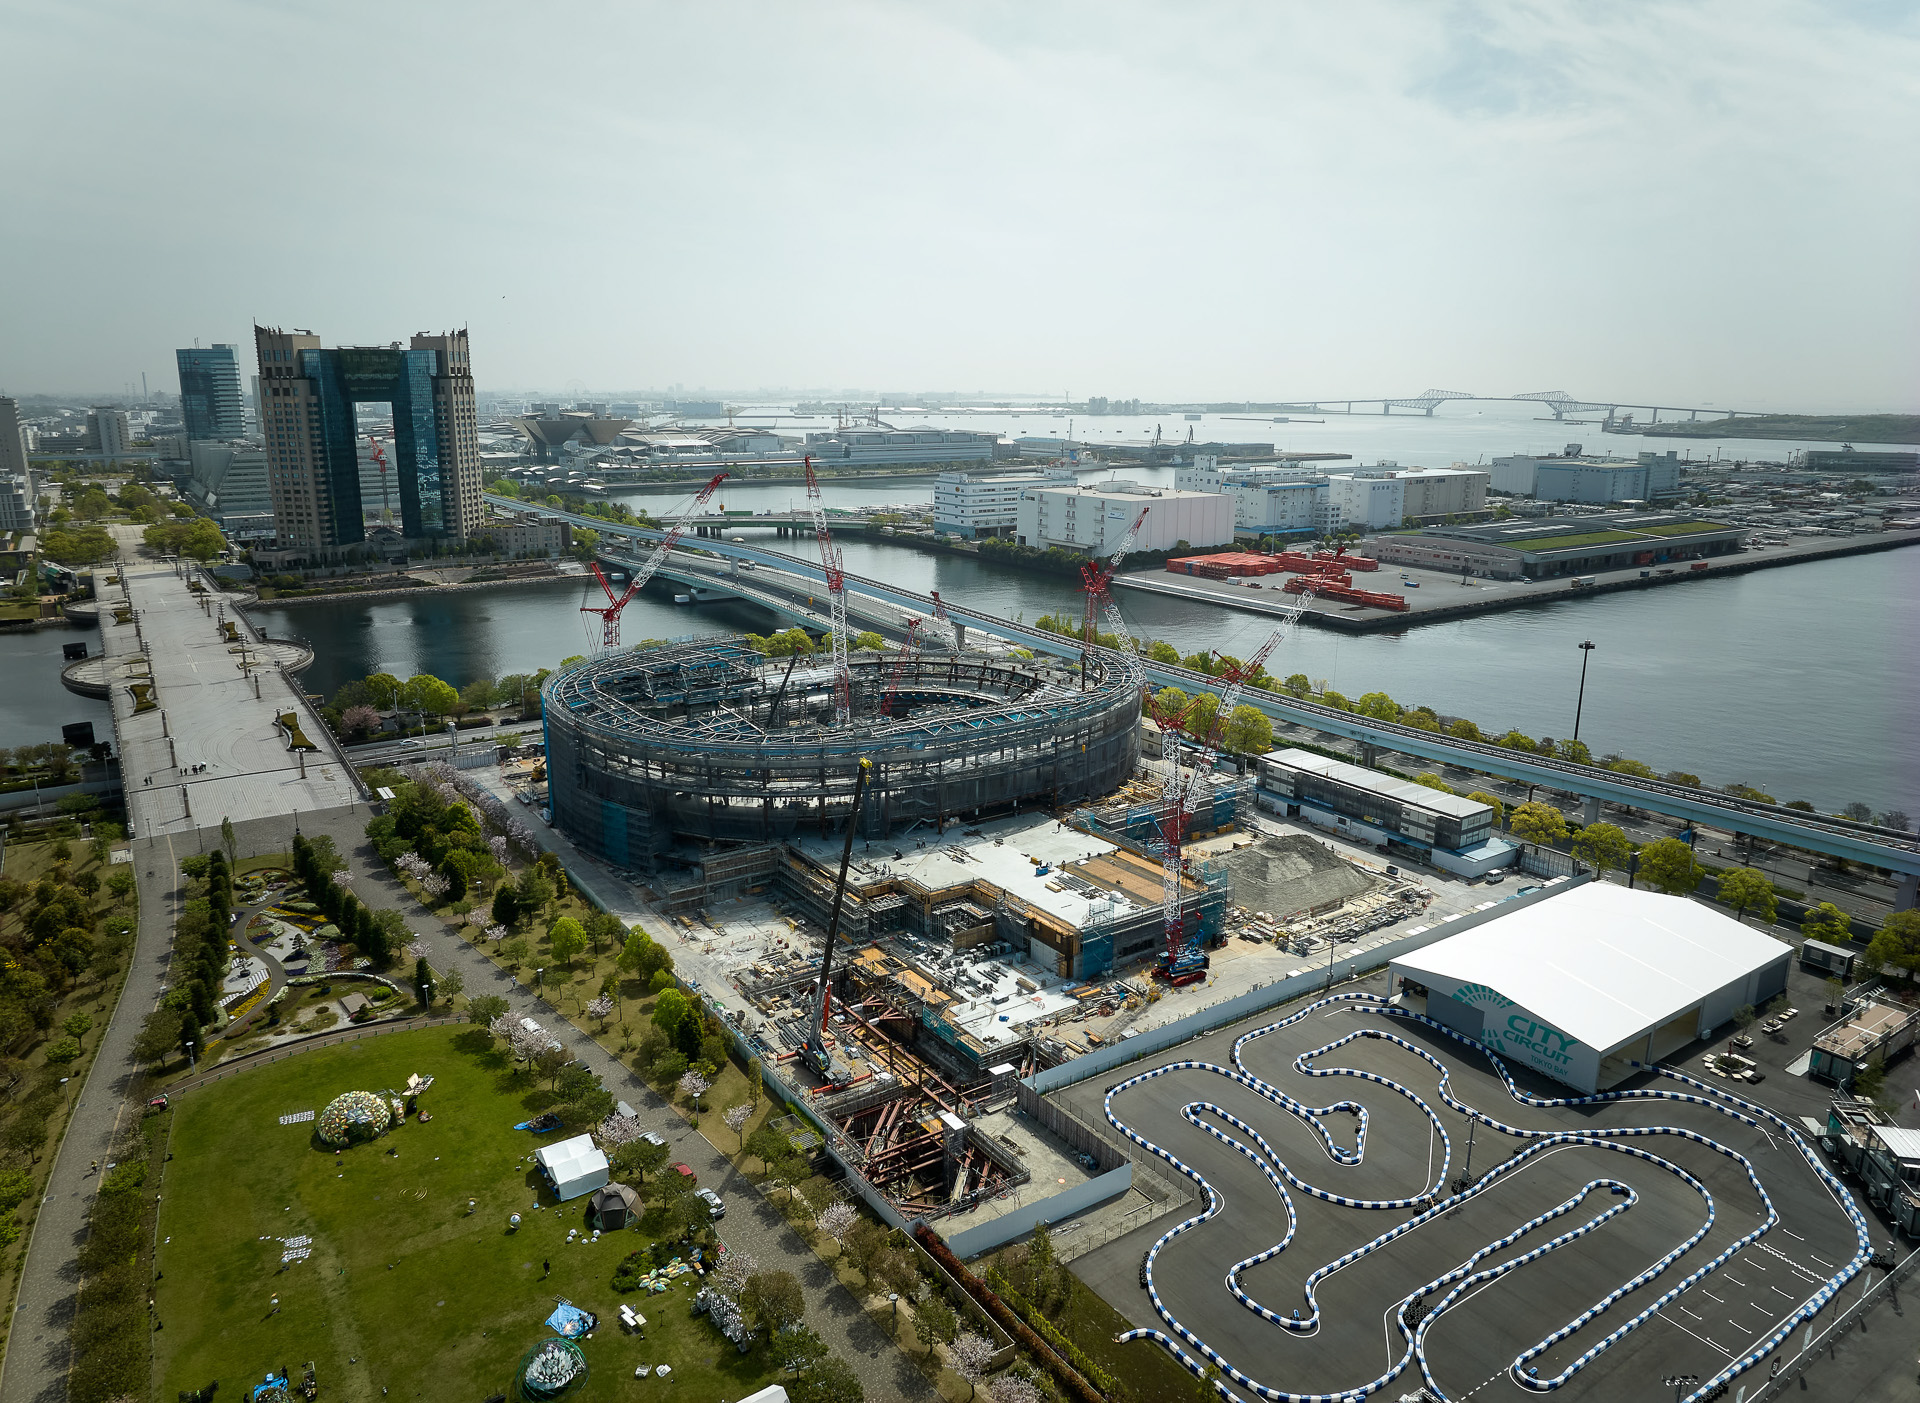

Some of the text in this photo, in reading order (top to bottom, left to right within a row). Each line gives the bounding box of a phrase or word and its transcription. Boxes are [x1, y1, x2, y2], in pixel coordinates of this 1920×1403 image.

[1503, 1030, 1573, 1065] CIRCUIT
[1508, 1015, 1578, 1052] CITY
[1531, 1055, 1568, 1076] TOKYO BAY
